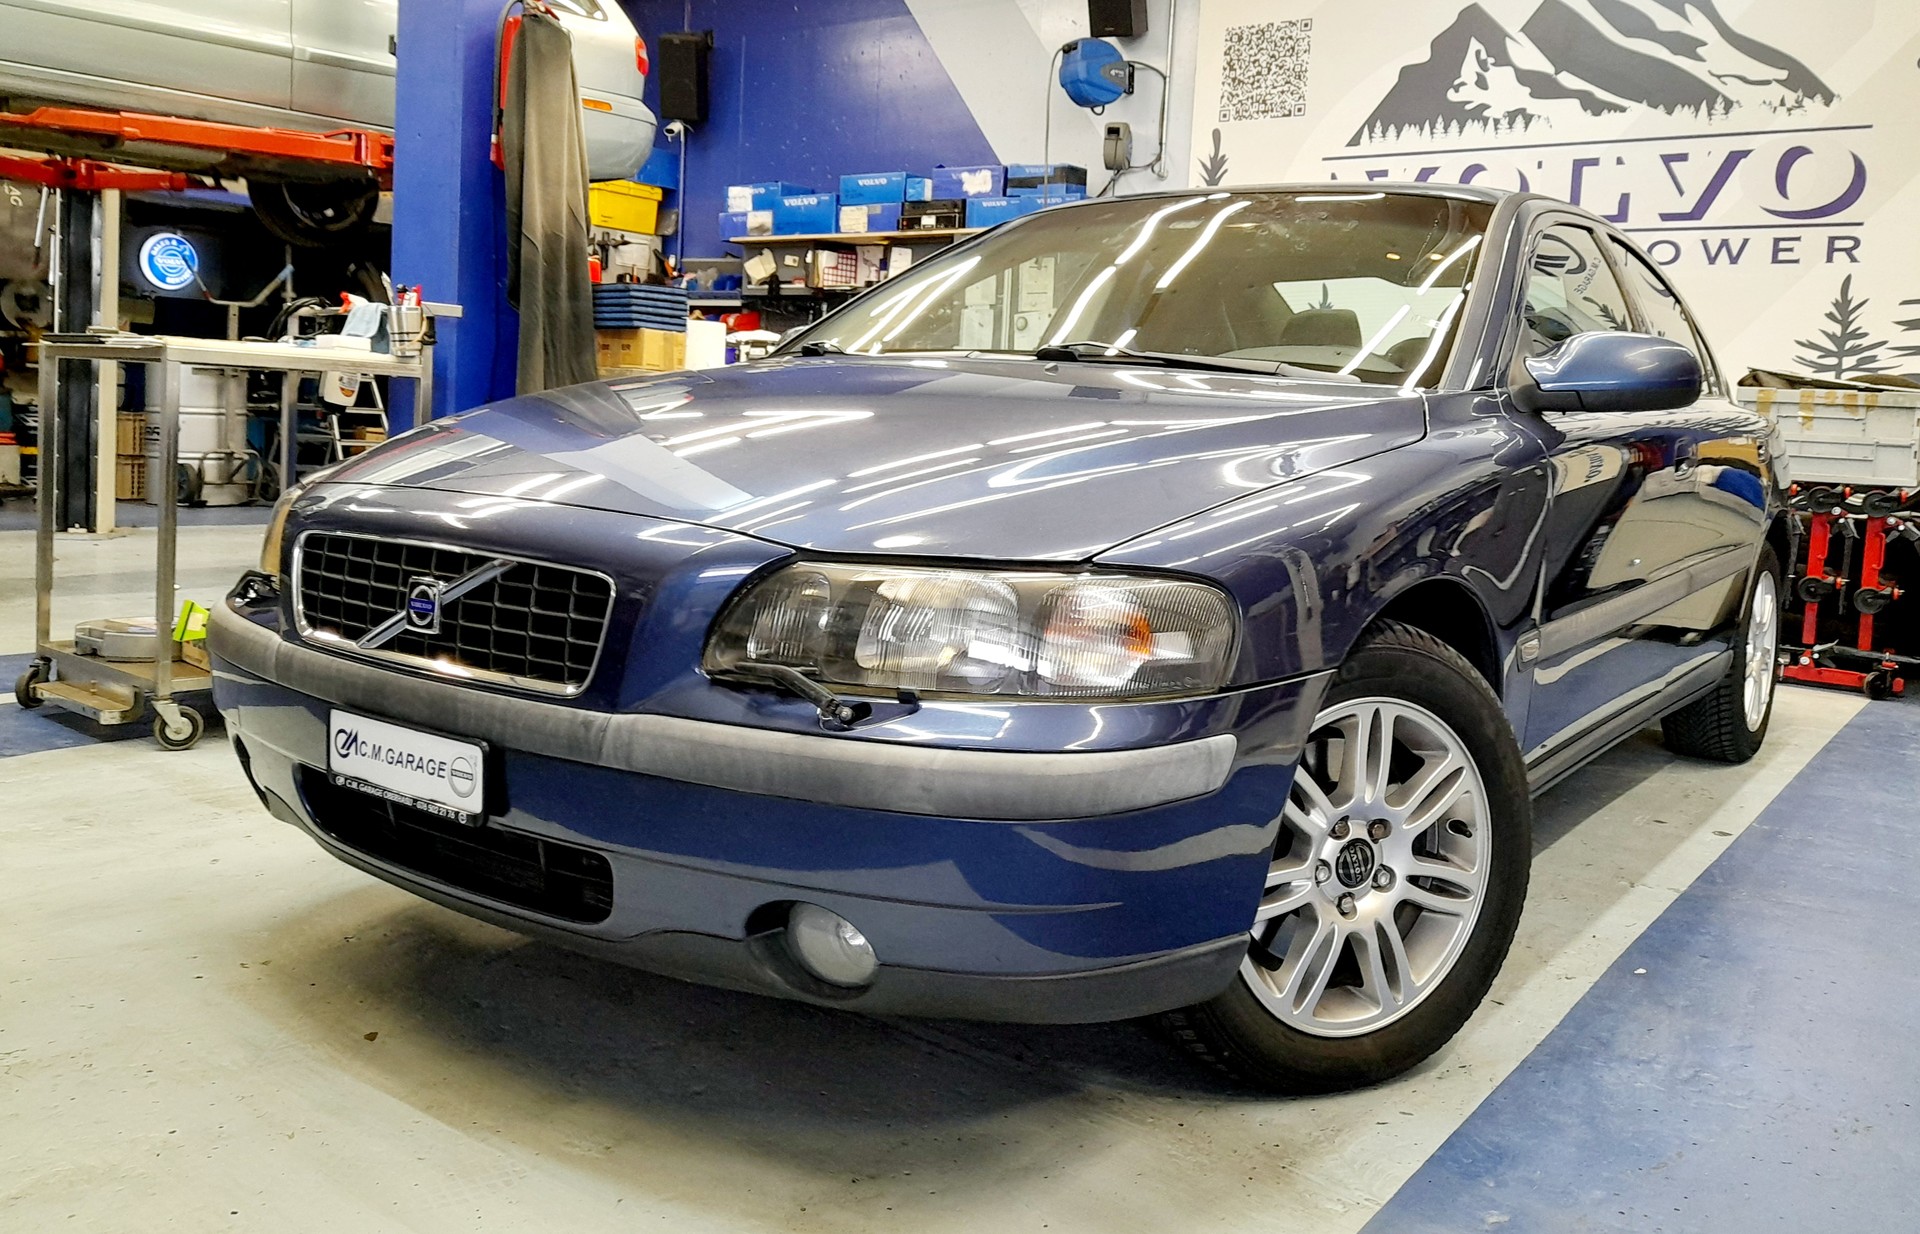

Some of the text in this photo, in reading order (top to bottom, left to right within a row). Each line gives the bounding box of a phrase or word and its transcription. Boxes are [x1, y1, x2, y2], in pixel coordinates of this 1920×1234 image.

[858, 178, 887, 187] VOLVO
[1330, 144, 1867, 223] LVO
[783, 197, 818, 207] VOLVO
[1644, 235, 1862, 266] OWER
[1348, 845, 1362, 884] VOLVO
